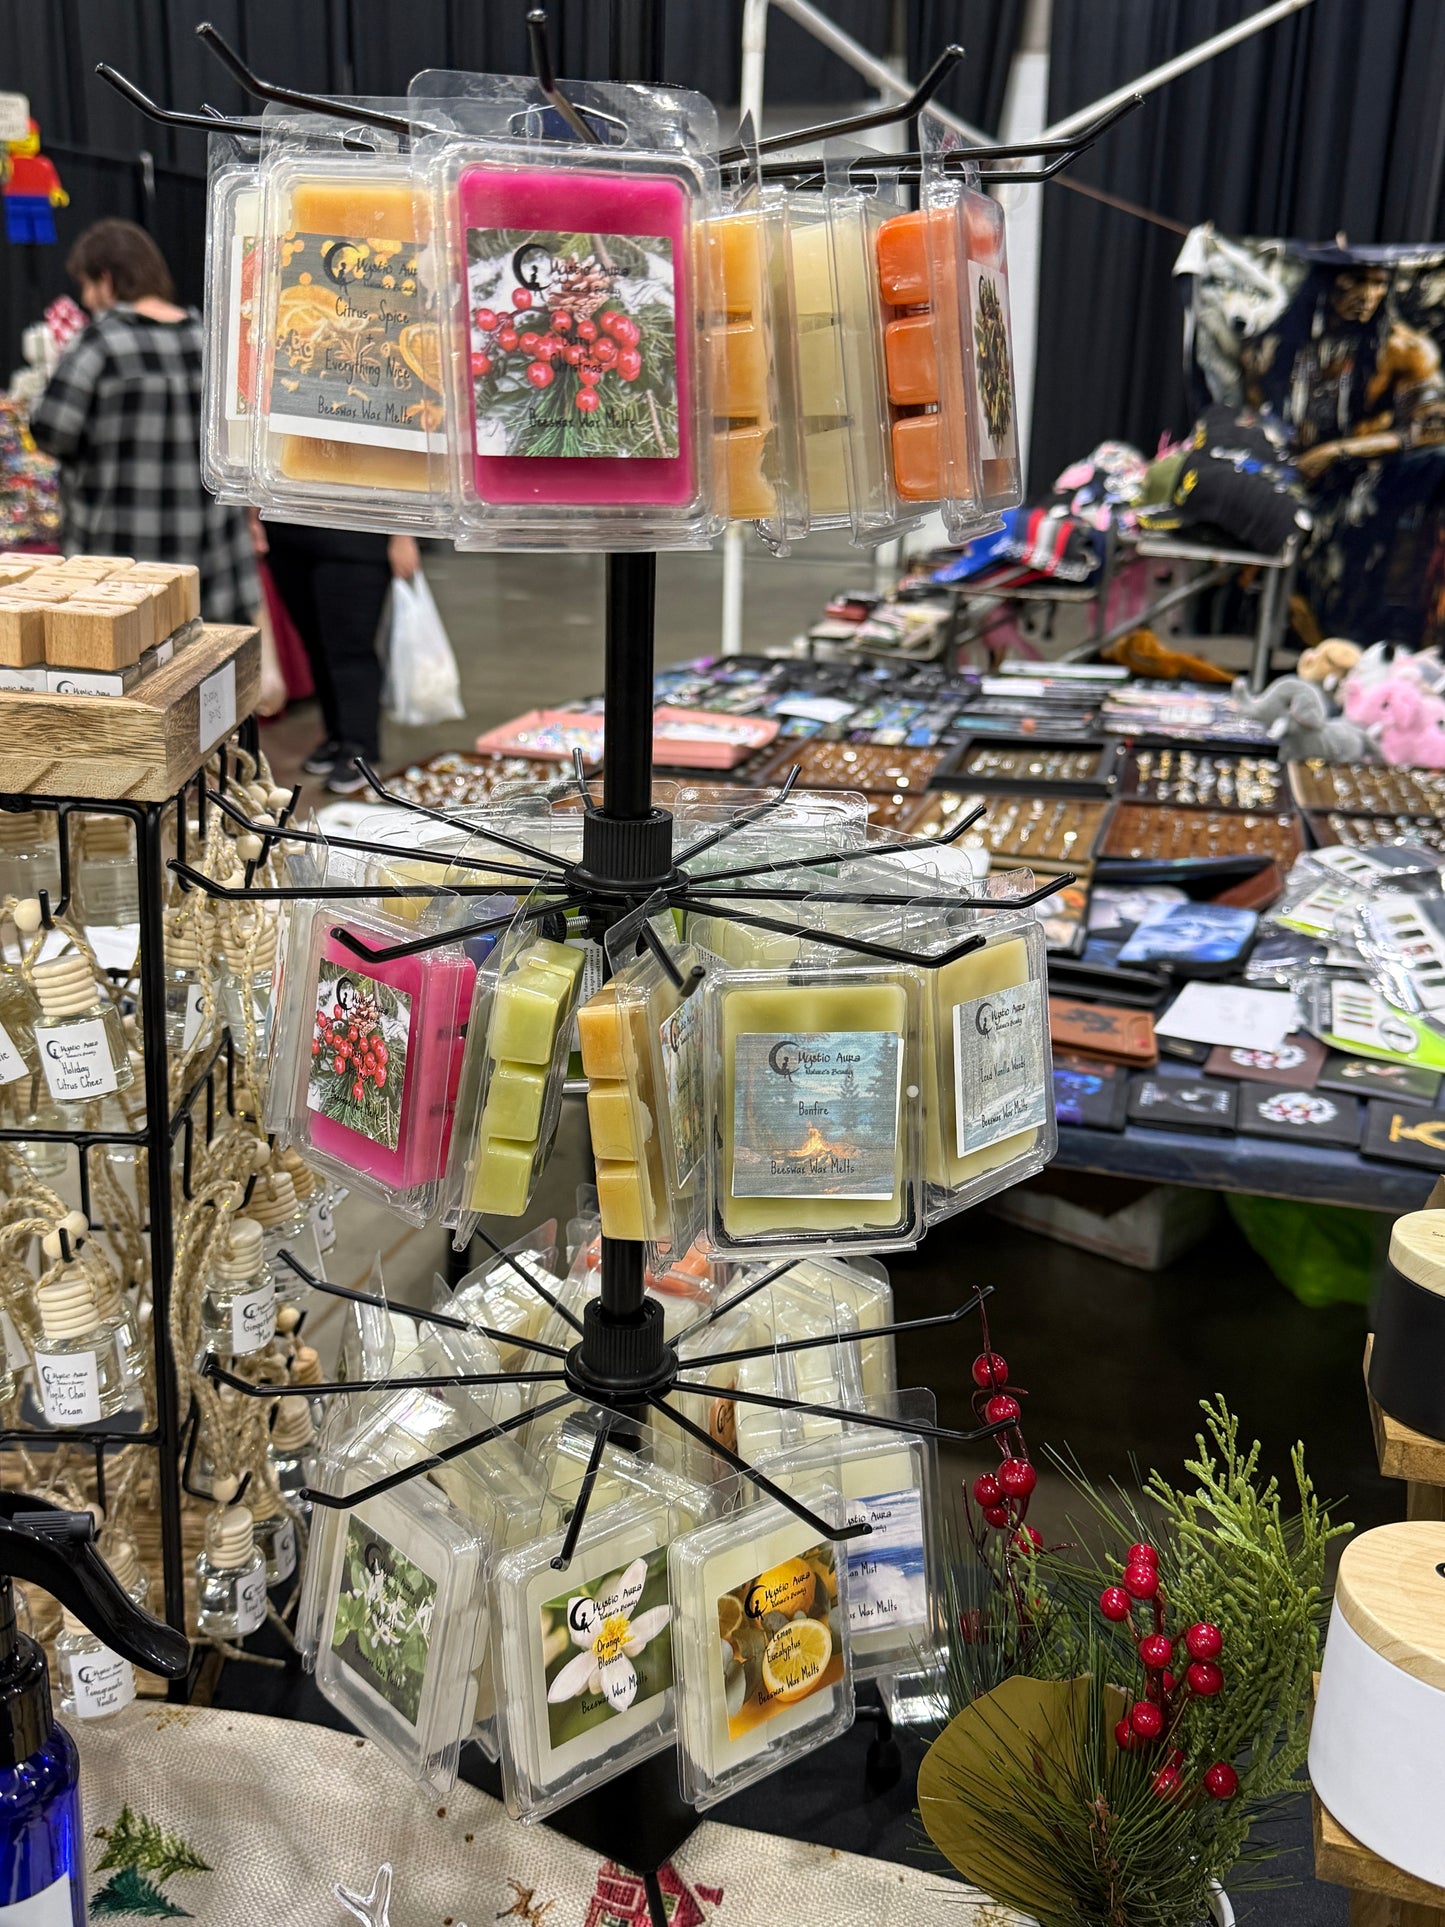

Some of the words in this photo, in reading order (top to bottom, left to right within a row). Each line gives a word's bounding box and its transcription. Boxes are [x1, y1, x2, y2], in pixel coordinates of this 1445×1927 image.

[335, 296, 371, 321] Citrus,
[378, 299, 409, 334] Spice
[325, 348, 381, 387] Everything
[385, 356, 411, 379] Nice
[317, 395, 357, 419] Beeswax
[361, 400, 381, 421] Wax
[384, 402, 413, 425] Melts
[835, 1052, 861, 1065] Aura
[61, 1061, 90, 1079] Holiday
[980, 1067, 993, 1083] Iced
[993, 1060, 1010, 1077] Vanilla
[1011, 1055, 1026, 1071] Woods
[57, 1078, 79, 1090] Citrus
[80, 1076, 103, 1090] Cheer
[798, 1100, 829, 1116] Bonfire
[981, 1114, 1001, 1128] Beeswax
[1002, 1103, 1013, 1119] Wax
[1013, 1098, 1028, 1115] Melts
[770, 1160, 806, 1175] Beeswax
[809, 1158, 827, 1174] Wax
[830, 1157, 855, 1174] Melts
[58, 1402, 83, 1416] Cream
[870, 1510, 892, 1522] Aura
[860, 1561, 878, 1577] Mist
[792, 1571, 811, 1587] Aura
[622, 1583, 642, 1599] Aura
[858, 1602, 874, 1618] Wax
[876, 1599, 898, 1615] Melts
[771, 1627, 792, 1643] Lemon
[596, 1636, 622, 1653] Orange
[766, 1637, 801, 1664] Eucalyptus
[597, 1652, 623, 1671] Blossom
[581, 1696, 609, 1714] Beeswax
[611, 1682, 626, 1698] Wax
[628, 1671, 648, 1690] Melts
[757, 1685, 785, 1706] Beeswax
[785, 1673, 800, 1689] Wax
[801, 1661, 820, 1681] Melts
